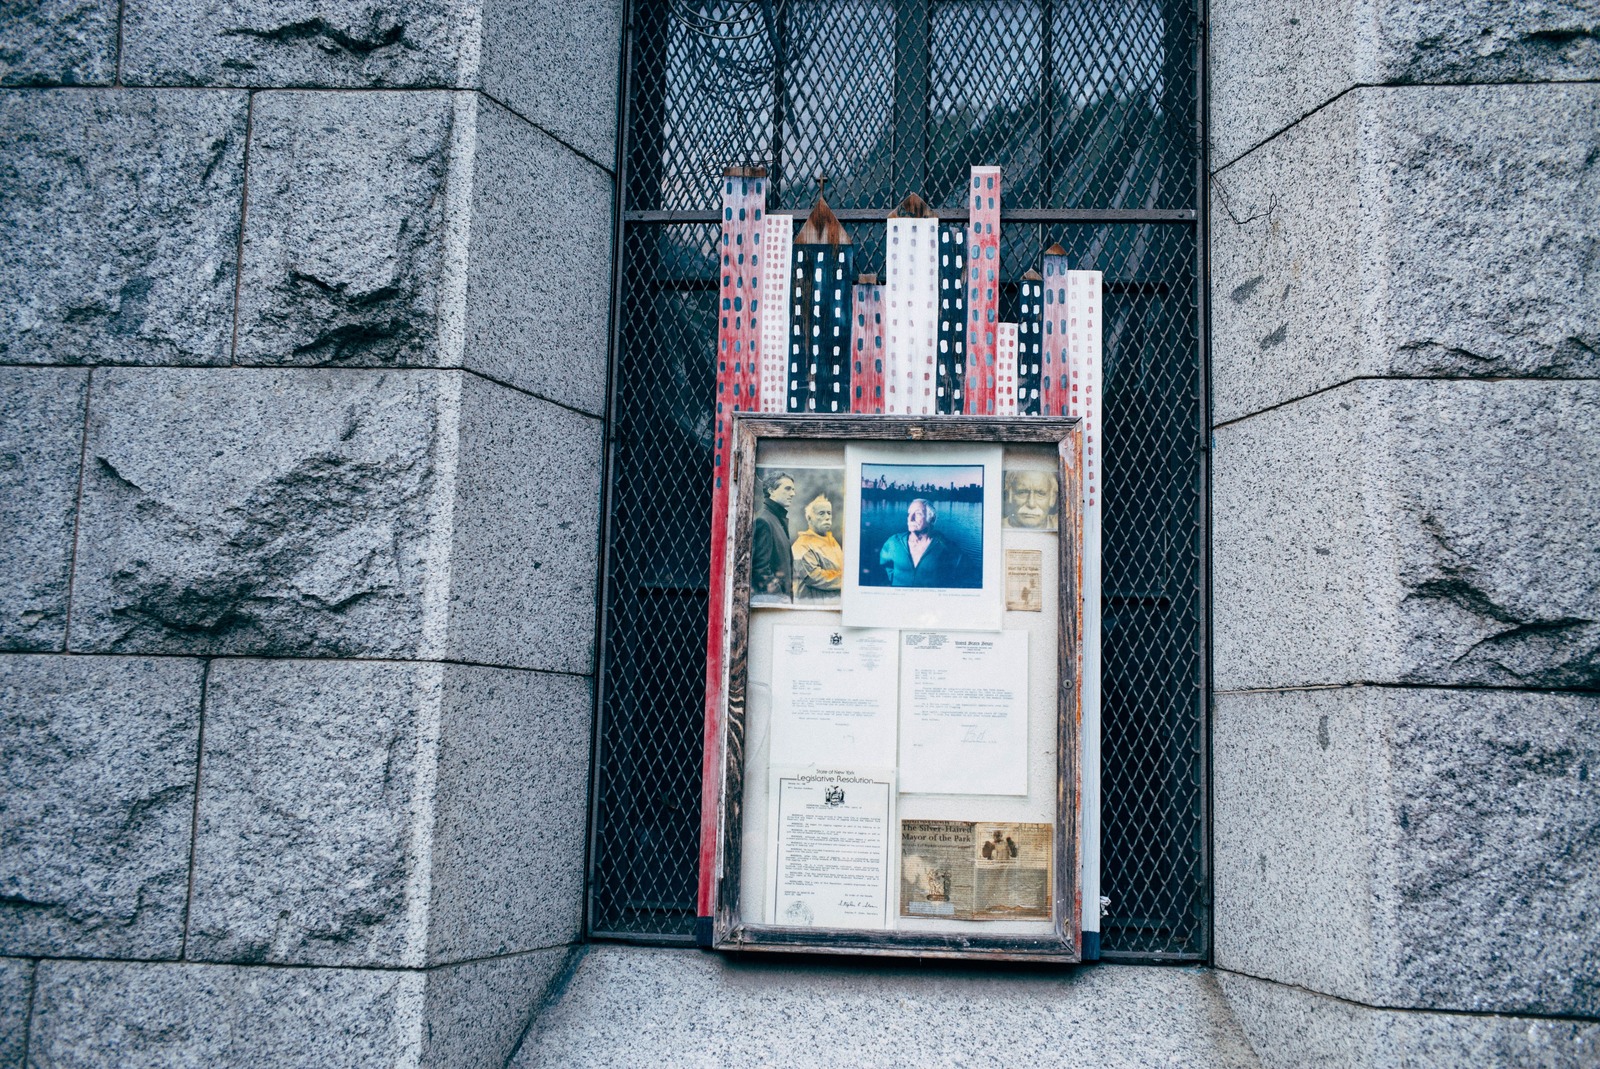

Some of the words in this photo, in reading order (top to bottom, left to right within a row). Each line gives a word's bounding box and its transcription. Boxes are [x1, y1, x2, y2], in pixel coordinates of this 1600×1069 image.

[796, 774, 835, 783] Legislative
[837, 776, 874, 784] Resolution
[920, 824, 972, 833] Silver-Haired
[902, 833, 926, 842] Mayor
